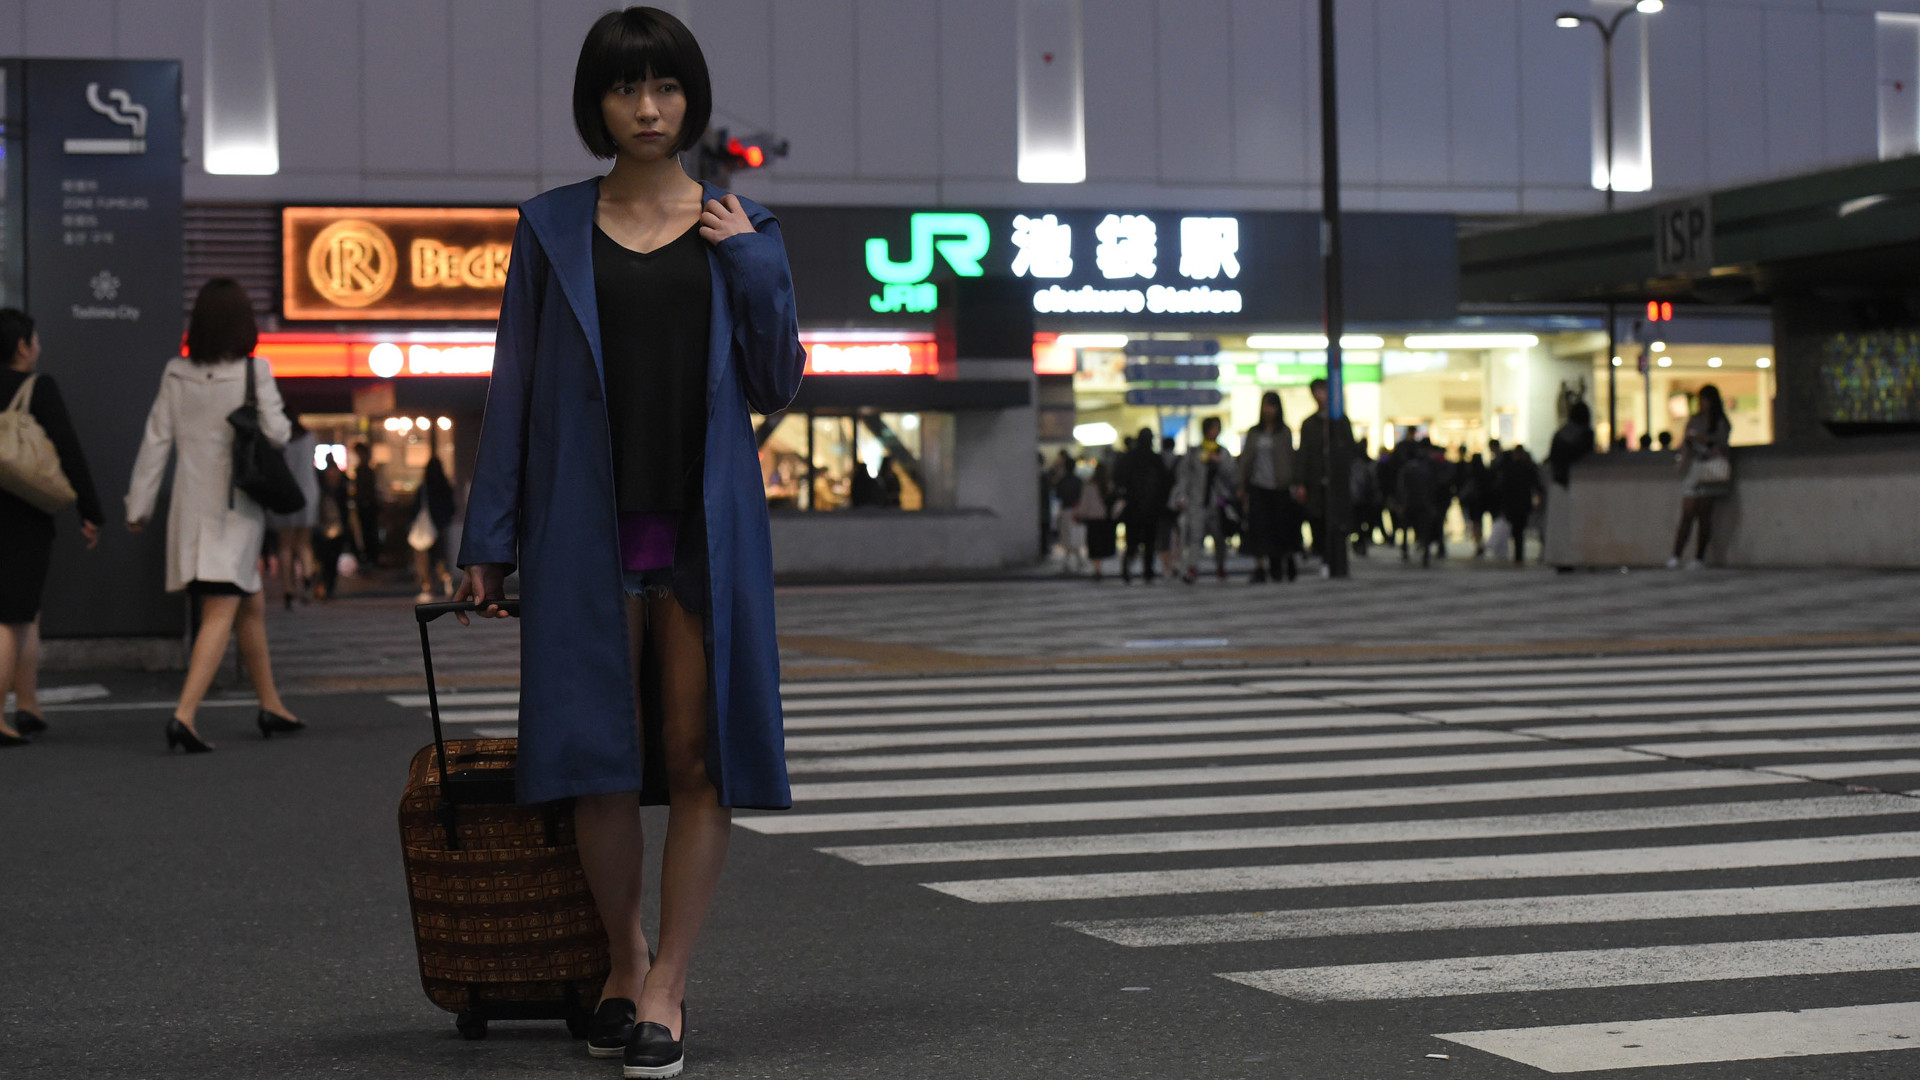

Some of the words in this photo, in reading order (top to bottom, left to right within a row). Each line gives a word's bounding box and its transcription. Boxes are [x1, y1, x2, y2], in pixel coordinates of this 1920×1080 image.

[866, 213, 990, 284] JR
[1011, 214, 1241, 280] 池袋駅
[1661, 208, 1705, 264] ISP
[1146, 284, 1242, 313] Station
